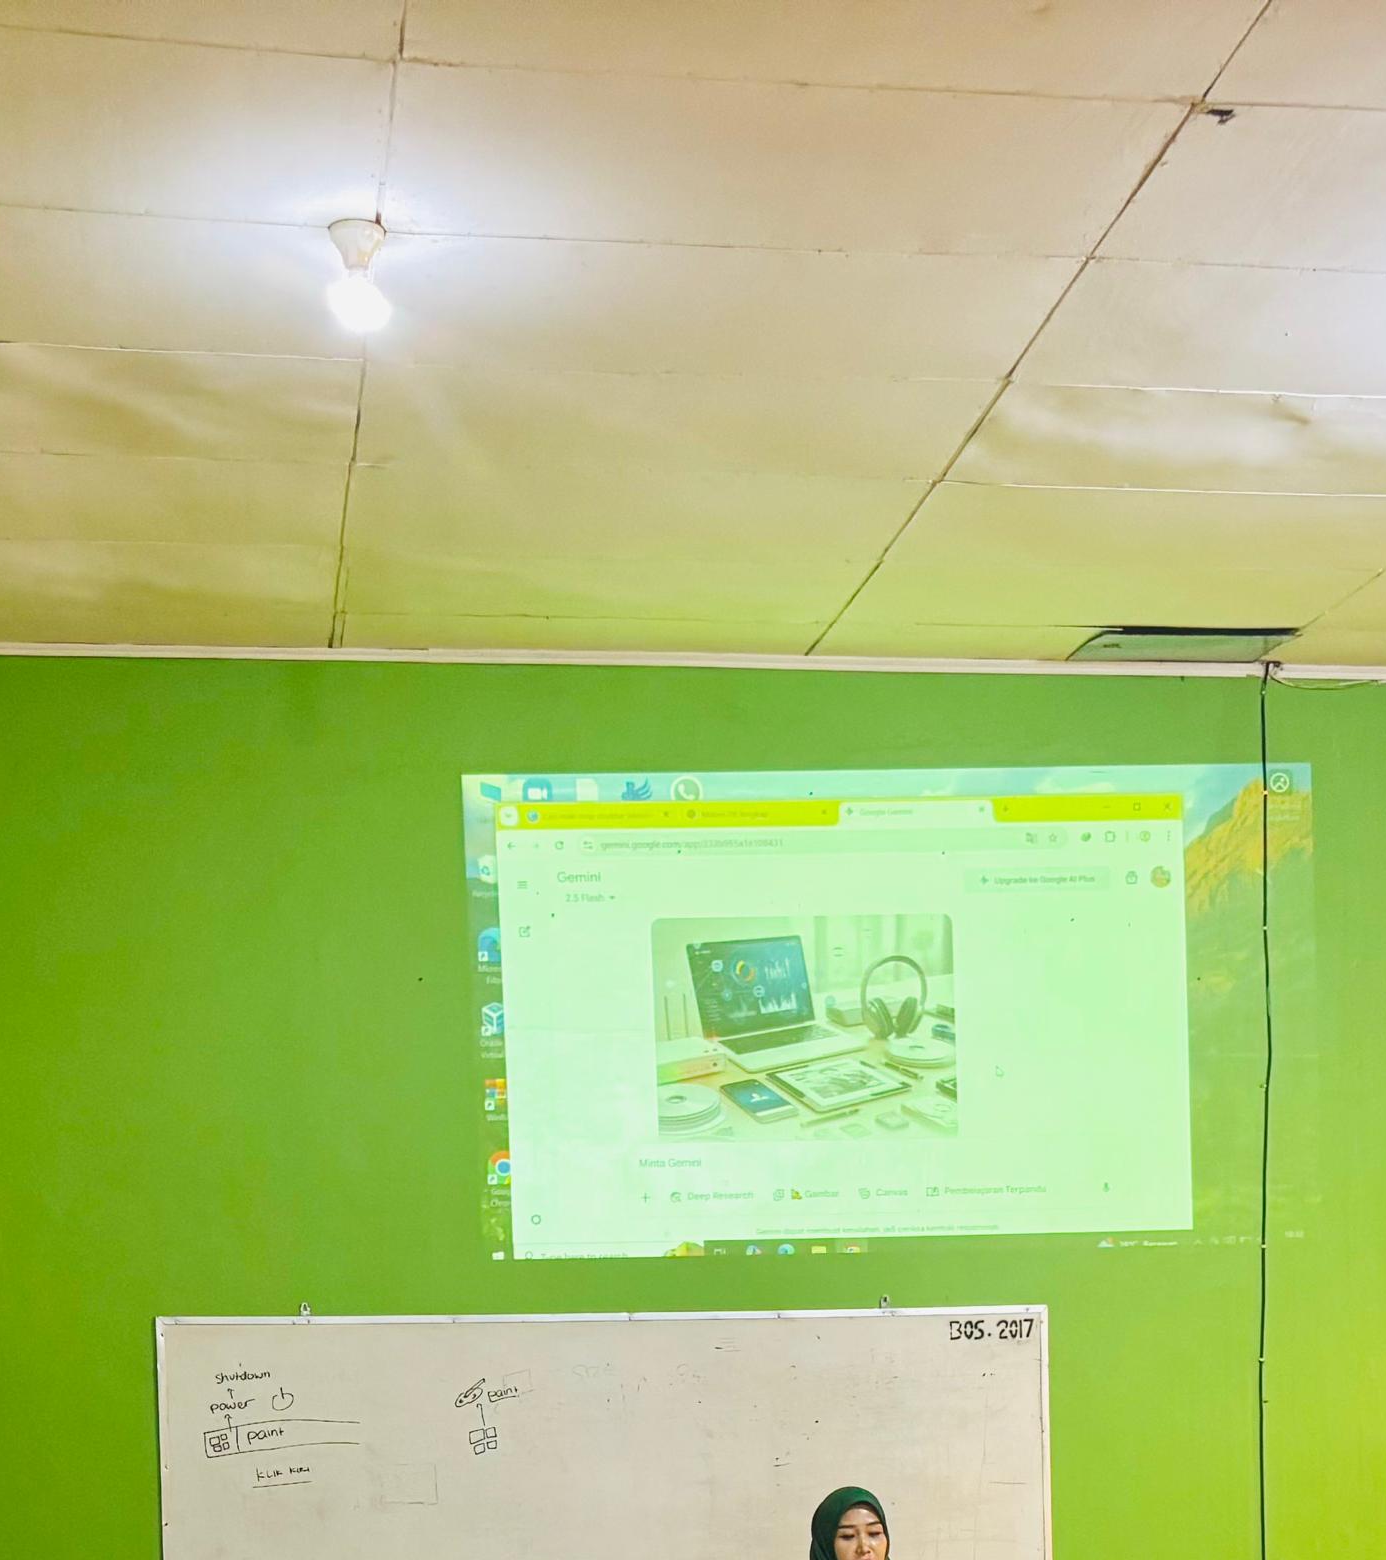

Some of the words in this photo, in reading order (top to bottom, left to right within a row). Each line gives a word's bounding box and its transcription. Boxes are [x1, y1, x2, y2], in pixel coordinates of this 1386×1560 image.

[557, 871, 601, 883] Gemini
[994, 875, 1027, 886] Upgrade
[1040, 875, 1067, 885] Google
[1078, 874, 1095, 883] Plus
[565, 893, 579, 902] 2.5
[581, 892, 605, 902] Flash
[639, 1158, 666, 1168] Minta
[668, 1158, 702, 1168] Gemini
[687, 1191, 710, 1201] Deep
[712, 1190, 754, 1200] Research
[876, 1187, 909, 1197] Canvas
[996, 1318, 1034, 1339] 2017
[215, 1370, 271, 1385] shutdown
[487, 1387, 519, 1402] paint
[210, 1398, 256, 1413] power
[246, 1426, 286, 1444] paint
